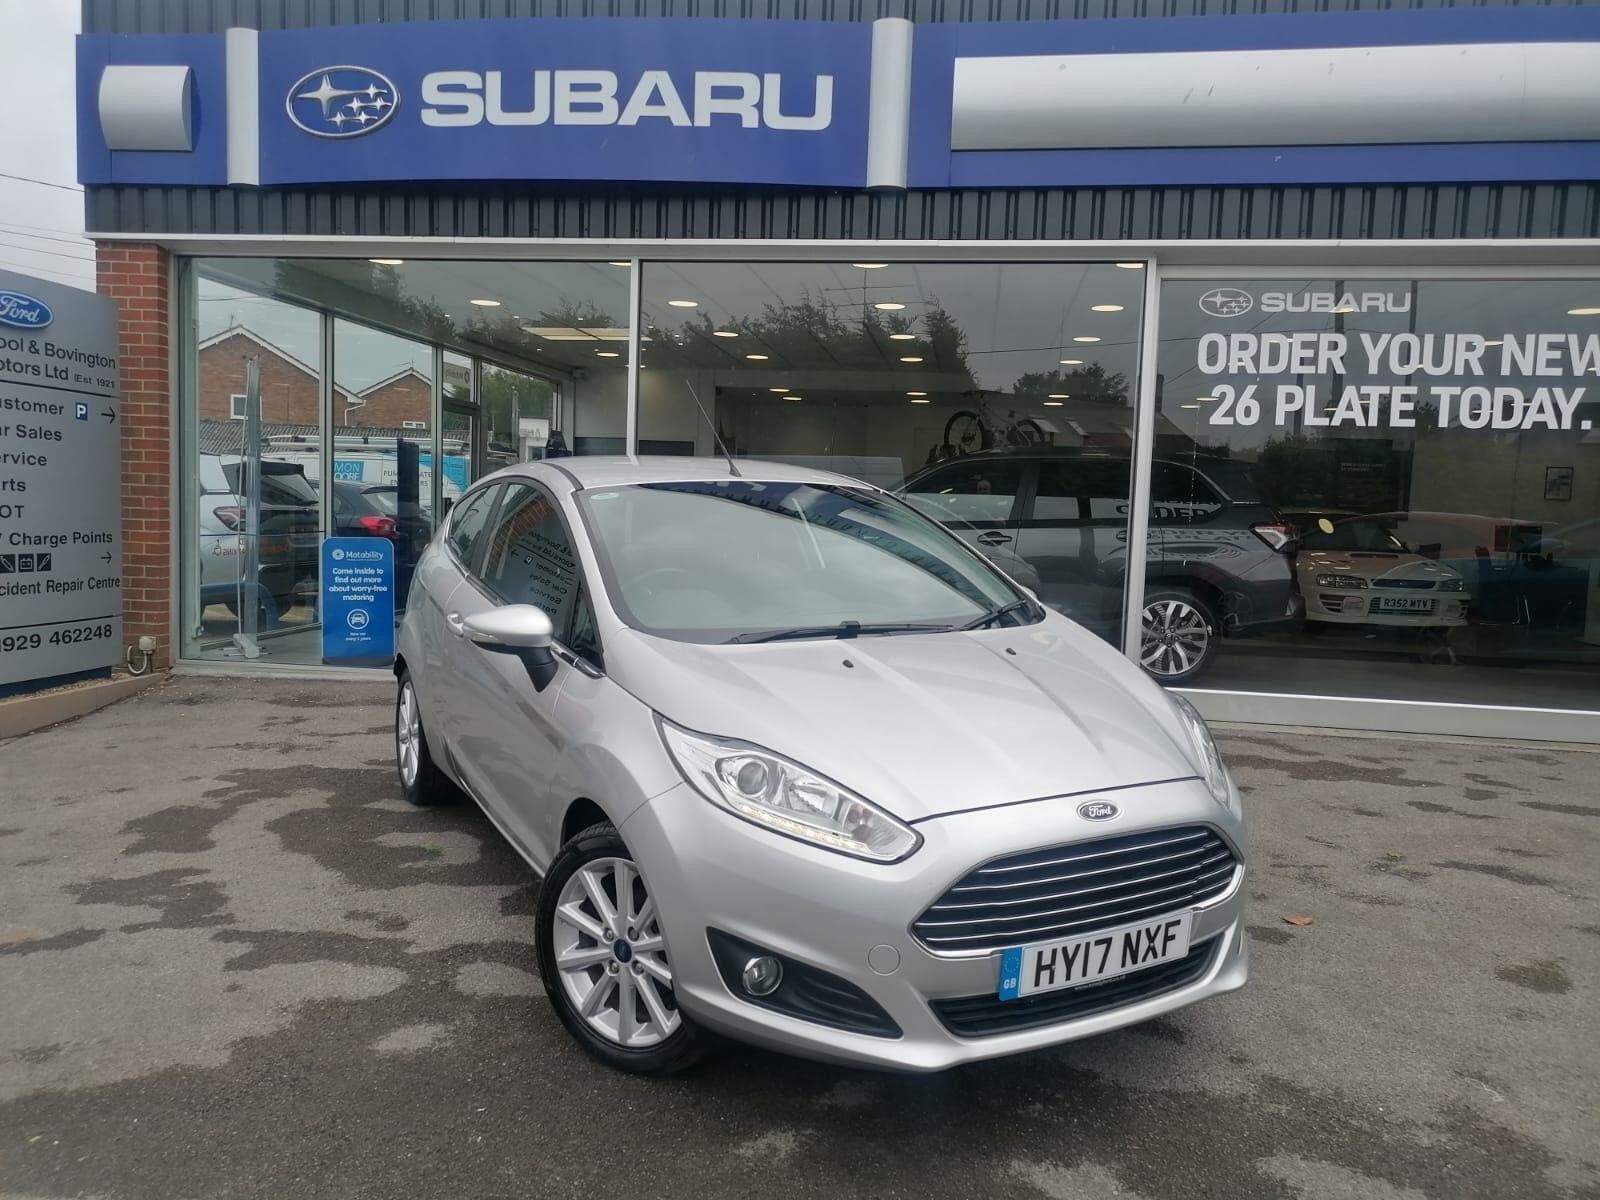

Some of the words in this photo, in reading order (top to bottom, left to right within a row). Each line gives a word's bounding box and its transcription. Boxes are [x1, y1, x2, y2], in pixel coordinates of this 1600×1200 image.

[420, 69, 834, 131] SUBARU
[0, 295, 40, 322] Ford
[1260, 291, 1412, 314] SUBARU
[28, 340, 40, 355] &
[44, 342, 116, 369] Bovington
[1197, 332, 1348, 376] ORDER
[1359, 332, 1486, 376] YOUR
[45, 364, 69, 380] Ltd
[1208, 384, 1260, 426] 26
[1274, 385, 1418, 428] PLATE
[1430, 386, 1593, 430] TODAY.
[16, 424, 62, 441] Sales
[9, 532, 68, 548] Charge
[73, 531, 113, 544] Points
[345, 551, 384, 560] Motability
[332, 567, 354, 575] Come
[354, 567, 376, 575] inside
[46, 578, 84, 595] Repair
[87, 577, 121, 590] Centre
[351, 585, 388, 593] worry-free
[342, 594, 375, 602] motoring
[1383, 597, 1409, 608] R352
[49, 624, 112, 646] 462248
[1088, 804, 1113, 817] Ford
[1003, 978, 1017, 989] GB
[1033, 936, 1114, 988] HY17
[1120, 918, 1182, 969] NXF
